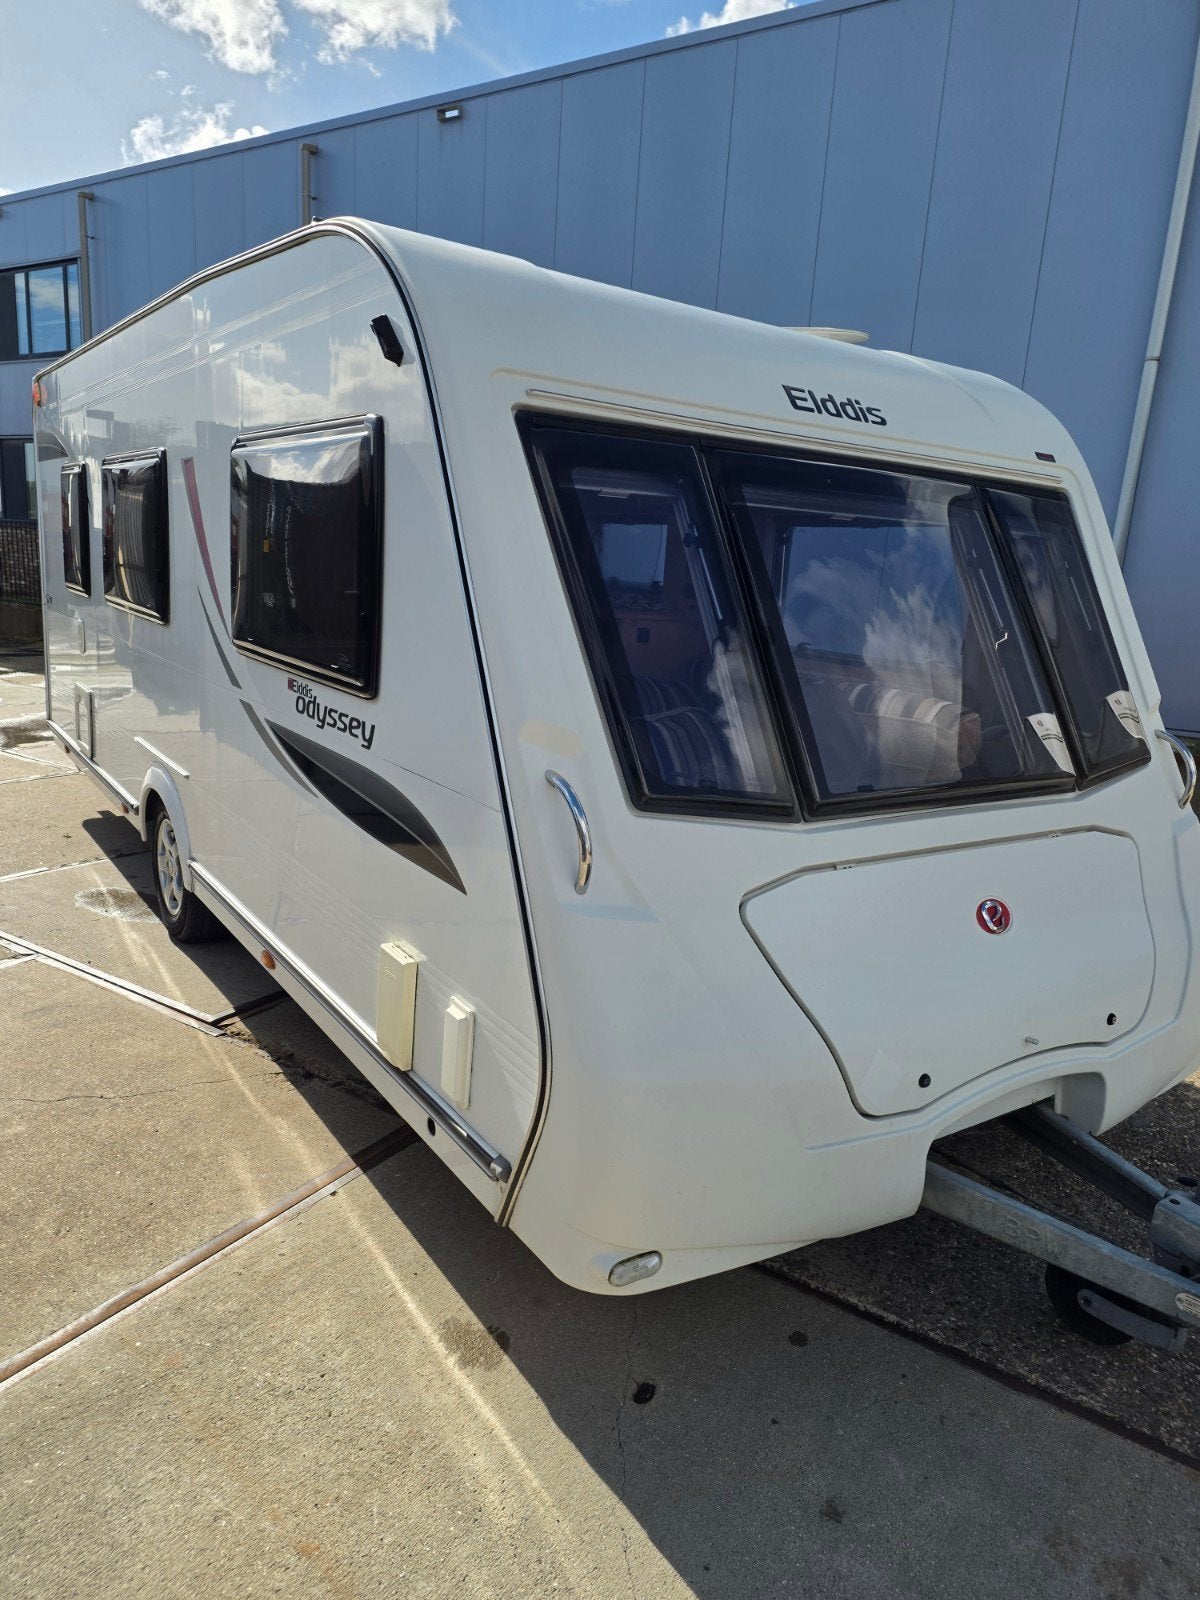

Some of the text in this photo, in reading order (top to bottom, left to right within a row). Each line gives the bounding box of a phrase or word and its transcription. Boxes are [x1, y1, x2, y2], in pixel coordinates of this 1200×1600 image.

[781, 384, 887, 426] Elddis
[292, 678, 312, 699] Elddis
[295, 695, 376, 750] odyssey
